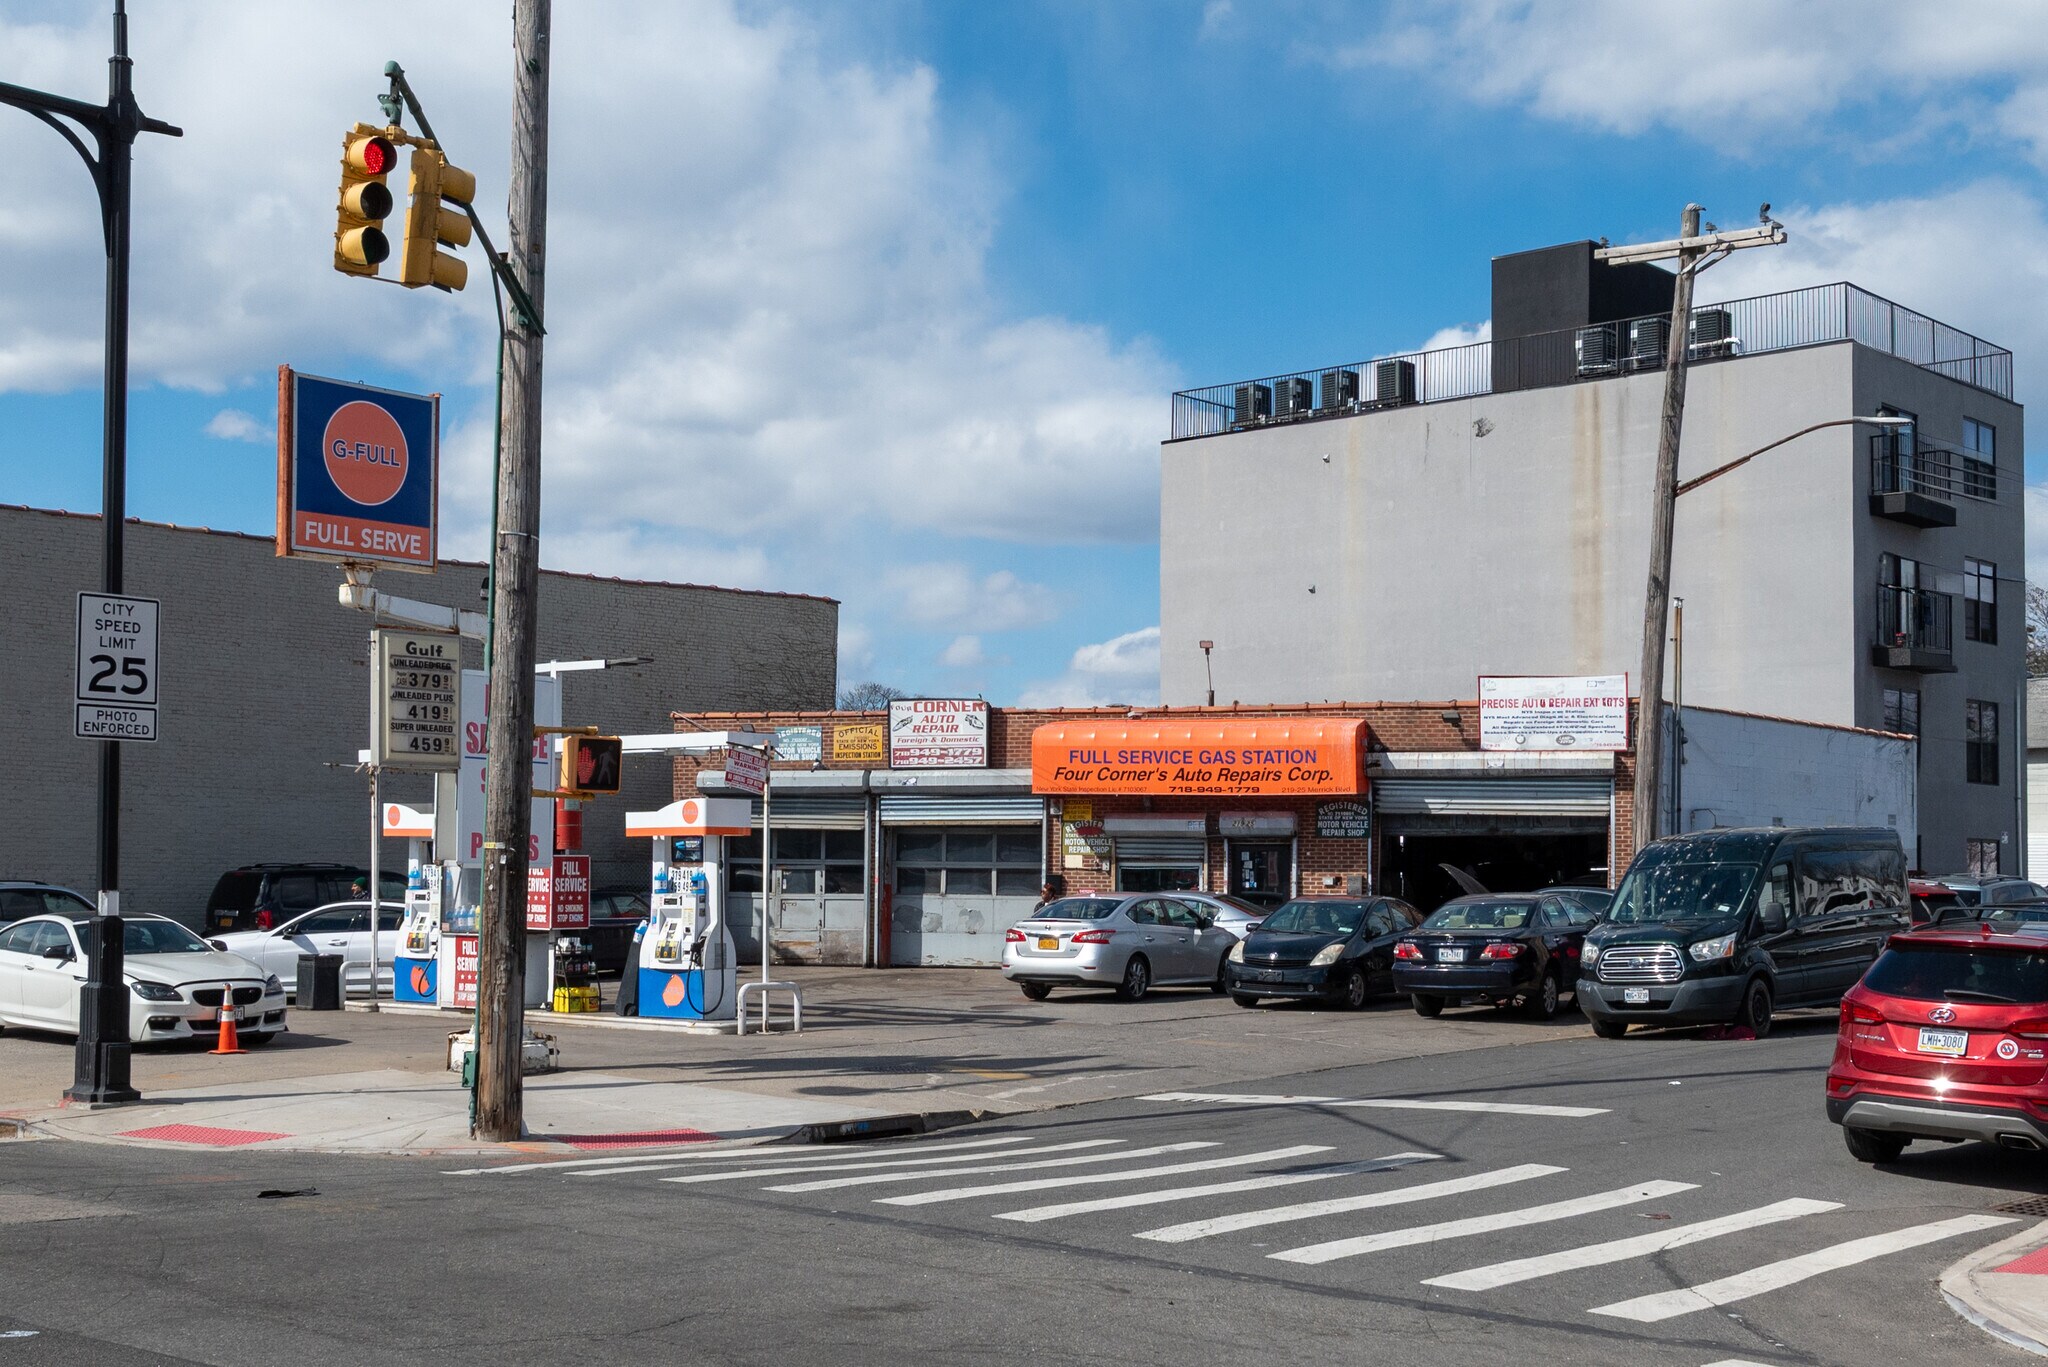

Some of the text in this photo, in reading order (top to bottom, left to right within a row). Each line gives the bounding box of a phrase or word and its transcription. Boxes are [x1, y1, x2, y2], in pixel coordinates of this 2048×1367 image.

[332, 439, 400, 468] G-FULL
[305, 520, 421, 555] FULL SERVE
[102, 602, 135, 616] CITY
[94, 618, 141, 634] SPEED
[100, 636, 136, 650] LIMIT
[406, 641, 444, 657] Gulf
[394, 658, 452, 670] UNLEADED REG
[88, 654, 148, 696] 25
[409, 672, 440, 688] 379
[434, 692, 454, 702] PLUS
[1482, 698, 1519, 708] PRECISE
[1548, 697, 1581, 708] REPAIR
[96, 710, 138, 722] PHOTO
[408, 704, 440, 720] 419
[921, 715, 955, 723] AUTO
[84, 722, 150, 735] ENFORCED
[390, 722, 453, 733] SUPER UNLEADED
[838, 726, 879, 738] OFFICIAL
[912, 725, 959, 733] REPAIR
[410, 736, 442, 752] 459
[1069, 750, 1317, 764] FULL SERVICE GAS STATION
[734, 761, 760, 772] WARNING
[1054, 767, 1334, 785] Four Corner's Auto Repairs Corp.
[1318, 802, 1368, 815] REGISTERED
[1065, 820, 1105, 834] REGISTER
[562, 861, 580, 876] FULL
[528, 877, 550, 893] ERVICE
[555, 877, 587, 892] SERVICE
[565, 904, 584, 913] SMOKING
[557, 914, 584, 923] STOP ENGINE
[457, 957, 478, 971] SERVIC
